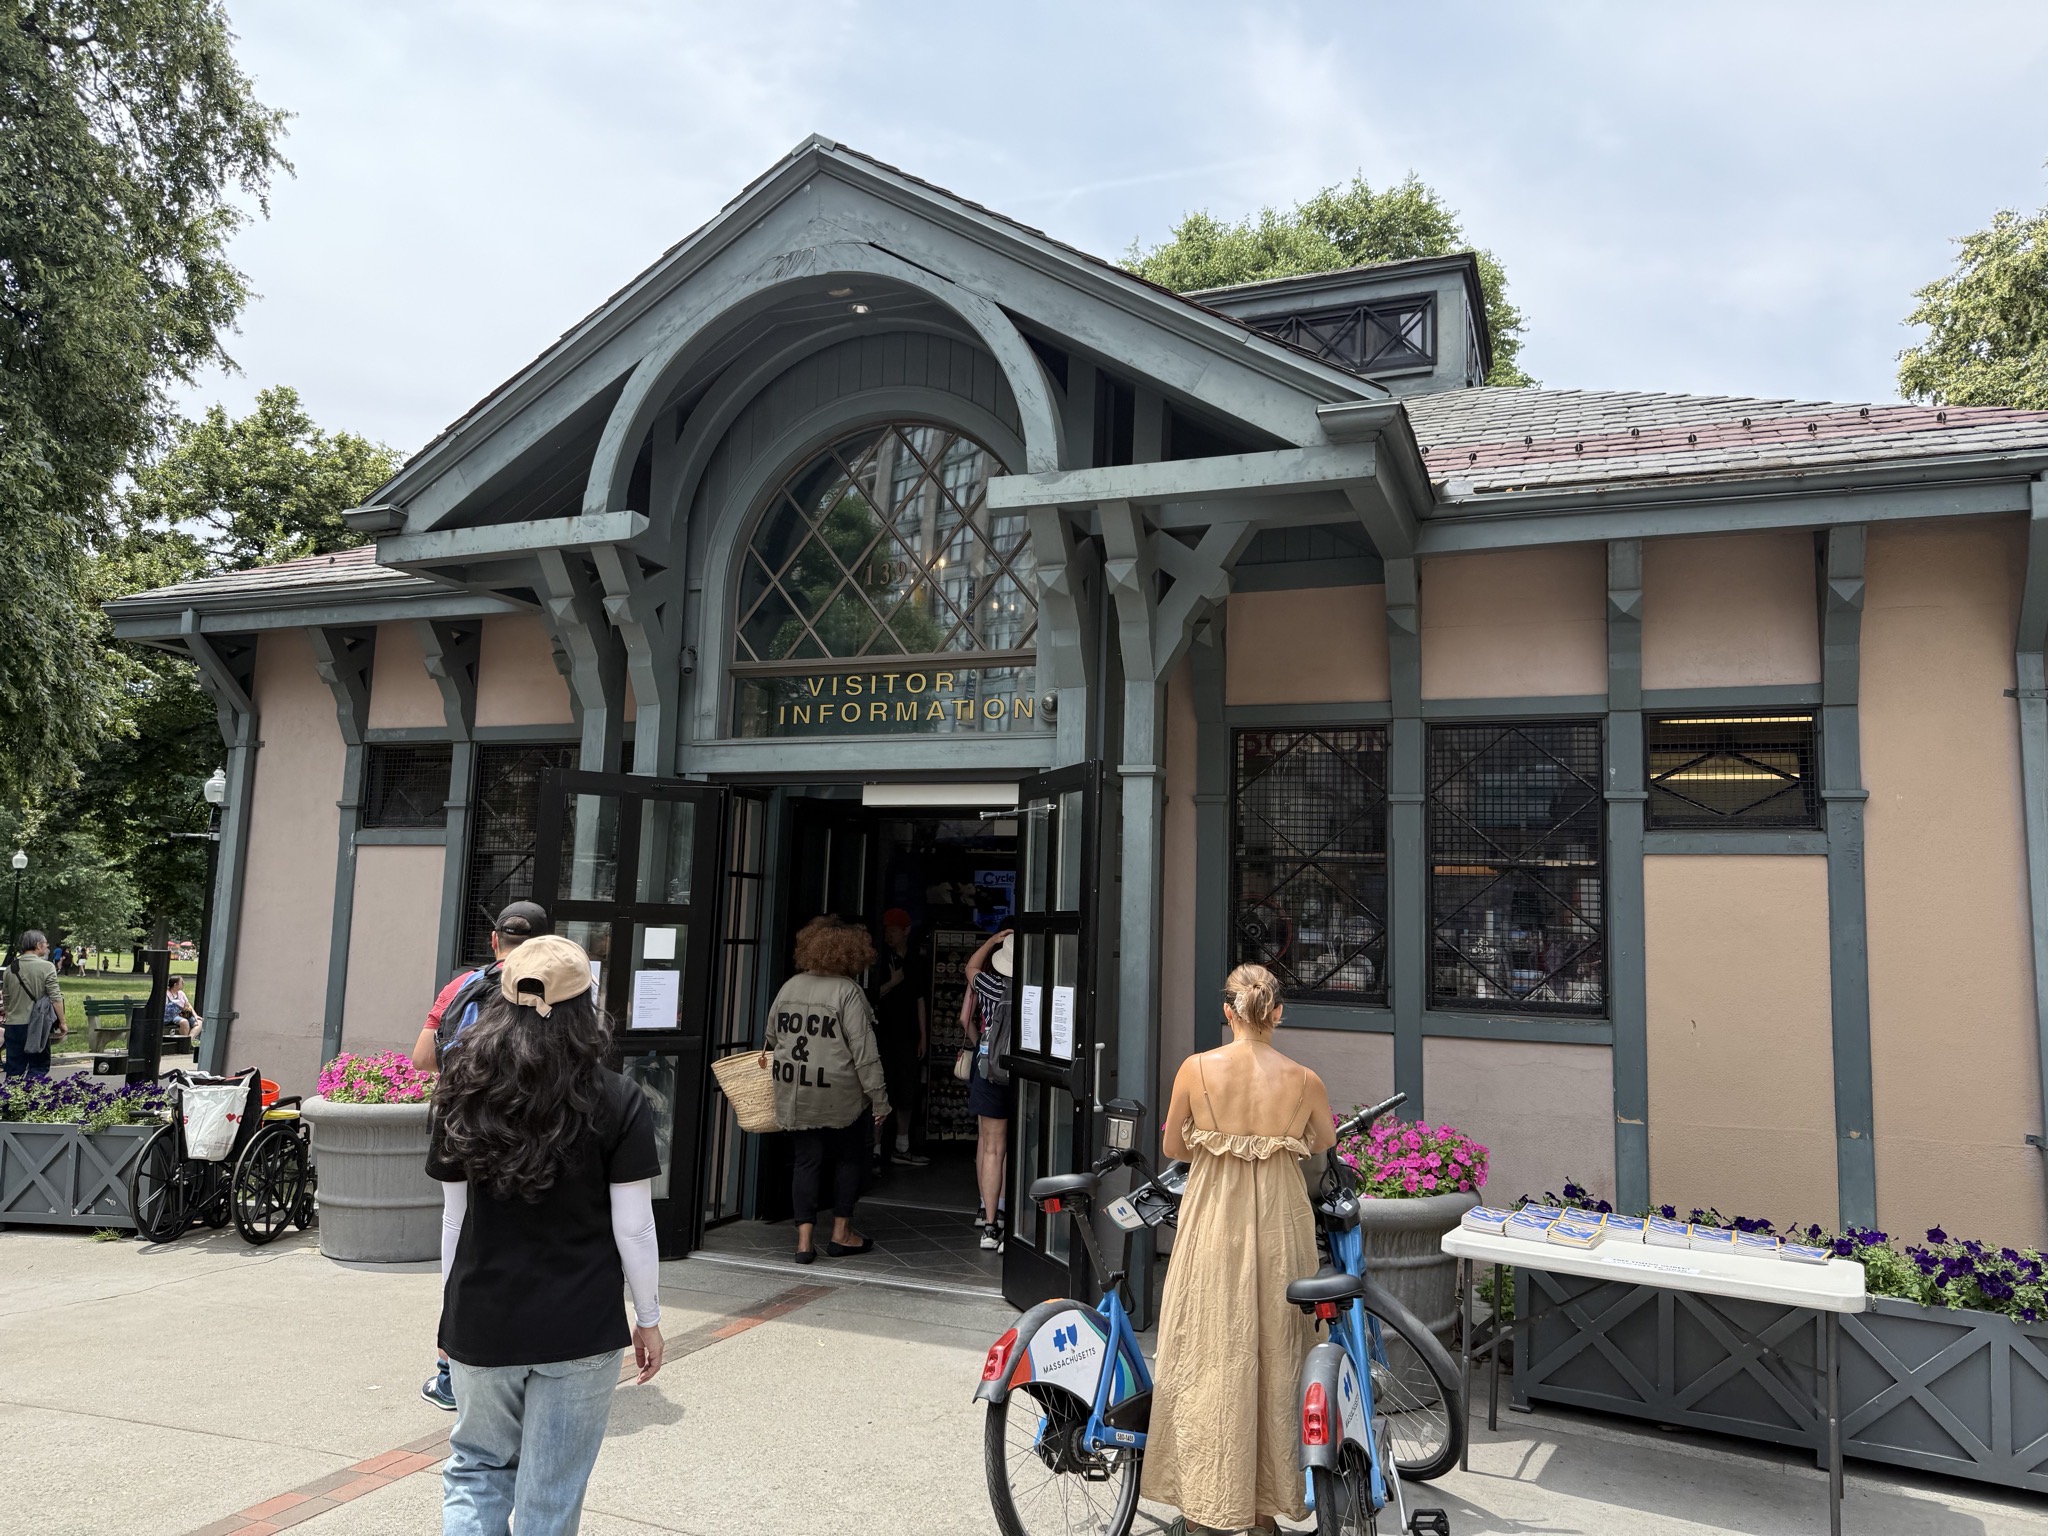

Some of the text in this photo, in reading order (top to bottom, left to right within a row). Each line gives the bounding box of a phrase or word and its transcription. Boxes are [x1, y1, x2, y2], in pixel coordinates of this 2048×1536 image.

[866, 561, 907, 585] 139
[807, 671, 955, 697] VISITOR
[779, 698, 1034, 725] INFORMATION
[983, 872, 1015, 884] Cycle
[777, 1012, 837, 1039] ROCK
[791, 1035, 810, 1062] &
[772, 1060, 831, 1088] ROLL
[1042, 1347, 1096, 1374] MASSACHUSETTS
